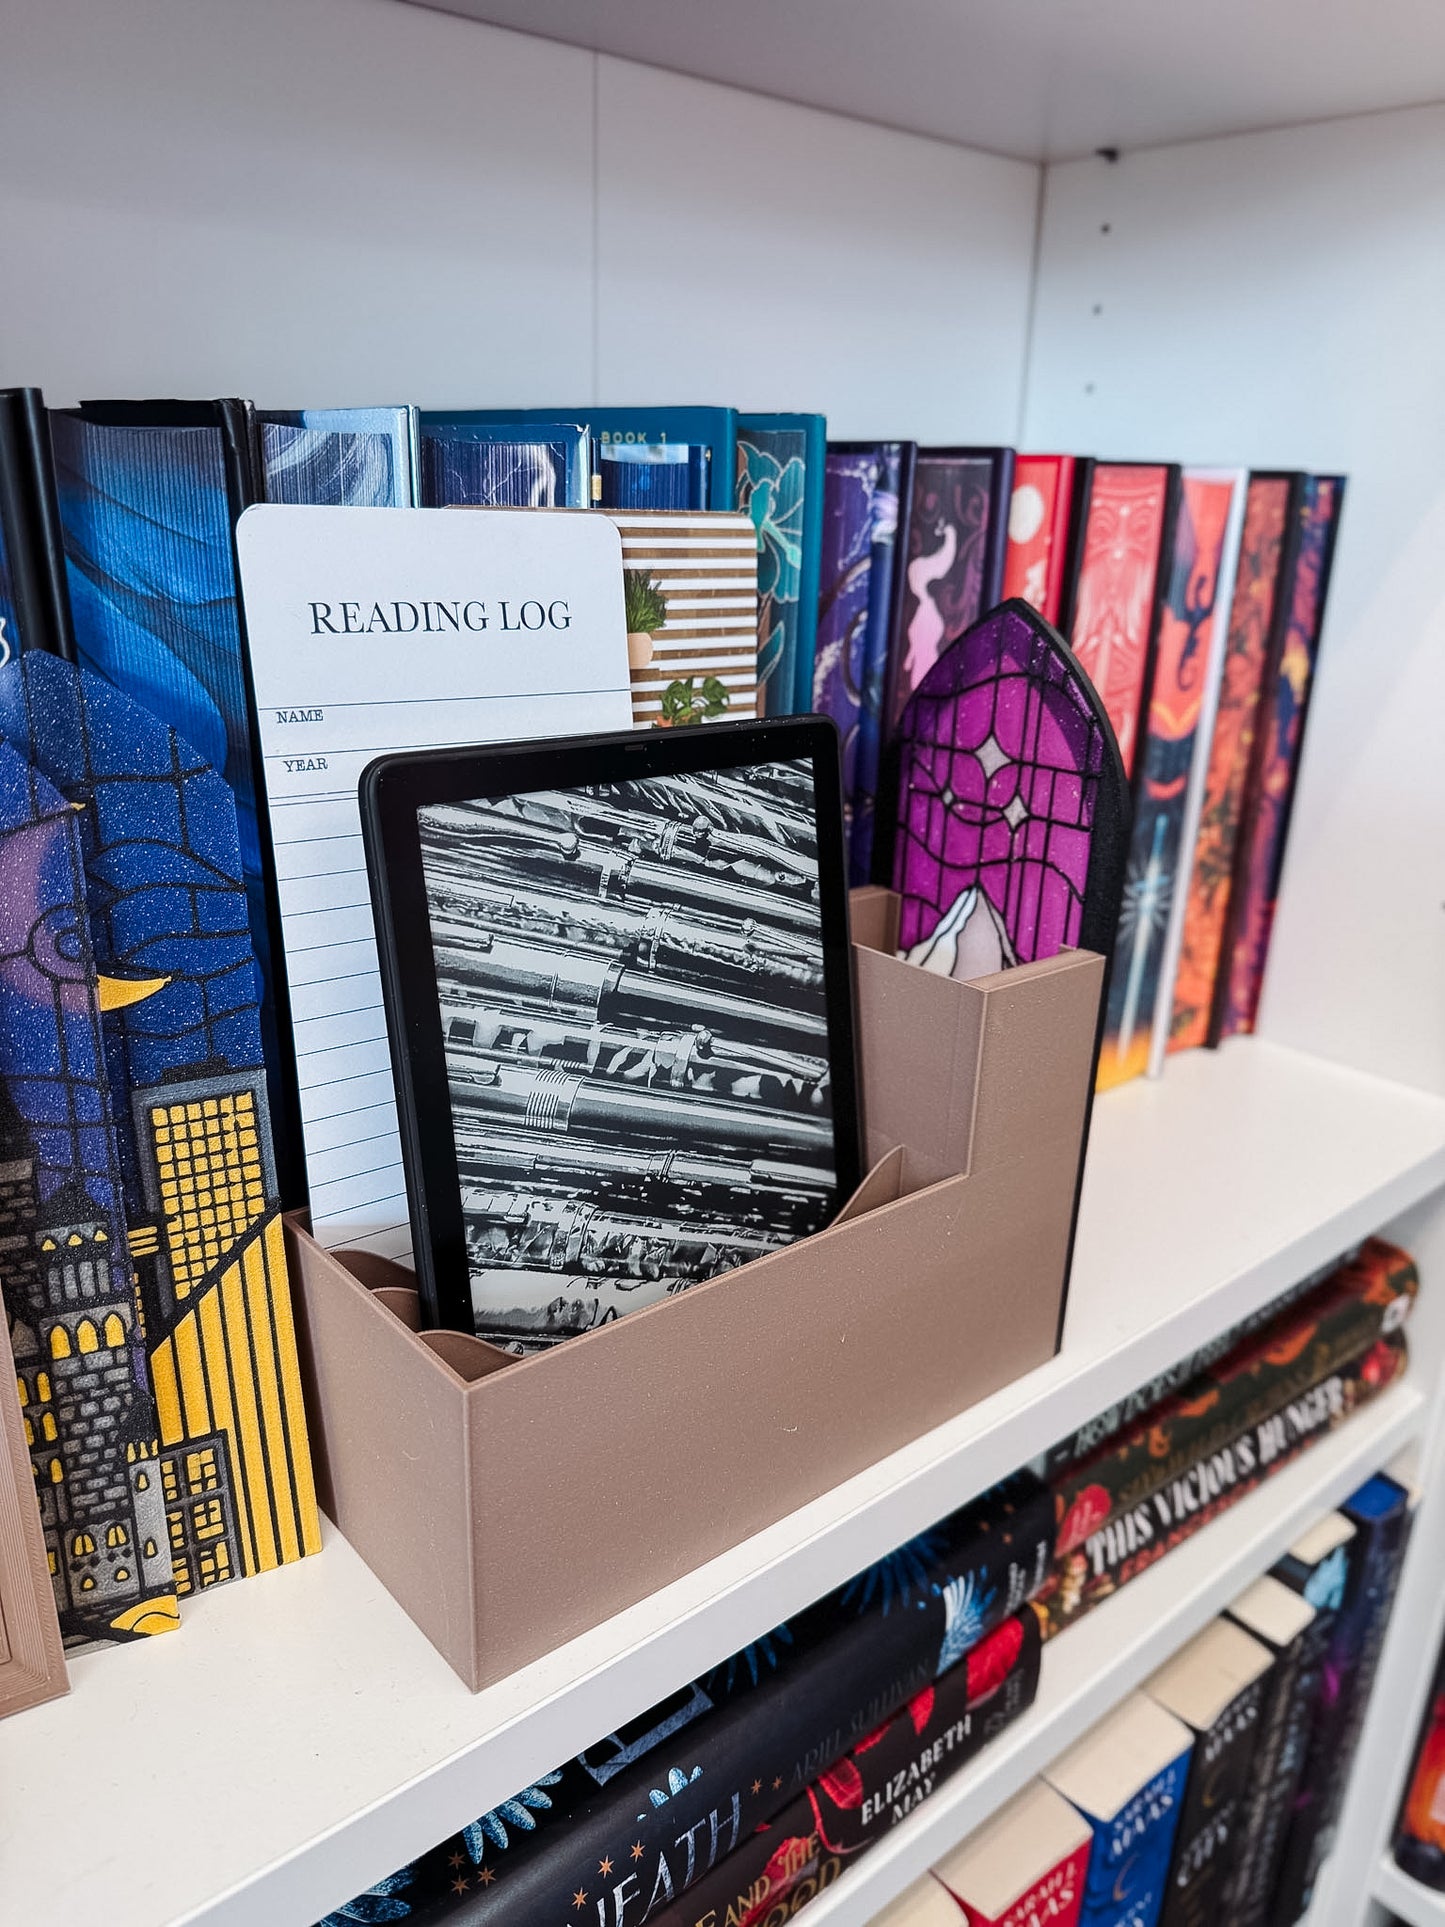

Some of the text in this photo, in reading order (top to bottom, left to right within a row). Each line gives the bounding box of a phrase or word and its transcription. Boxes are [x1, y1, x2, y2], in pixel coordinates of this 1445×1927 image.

[600, 431, 667, 445] BOOK 1
[308, 600, 572, 635] READING LOG
[276, 709, 324, 724] NAME
[283, 757, 328, 773] YEAR
[1085, 1502, 1154, 1576] THIS
[1153, 1434, 1256, 1526] VICIOUS
[1256, 1375, 1344, 1465] HUNGER
[861, 1714, 972, 1826] ELIZABETH
[892, 1772, 936, 1826] MAY
[777, 1830, 820, 1878] THE
